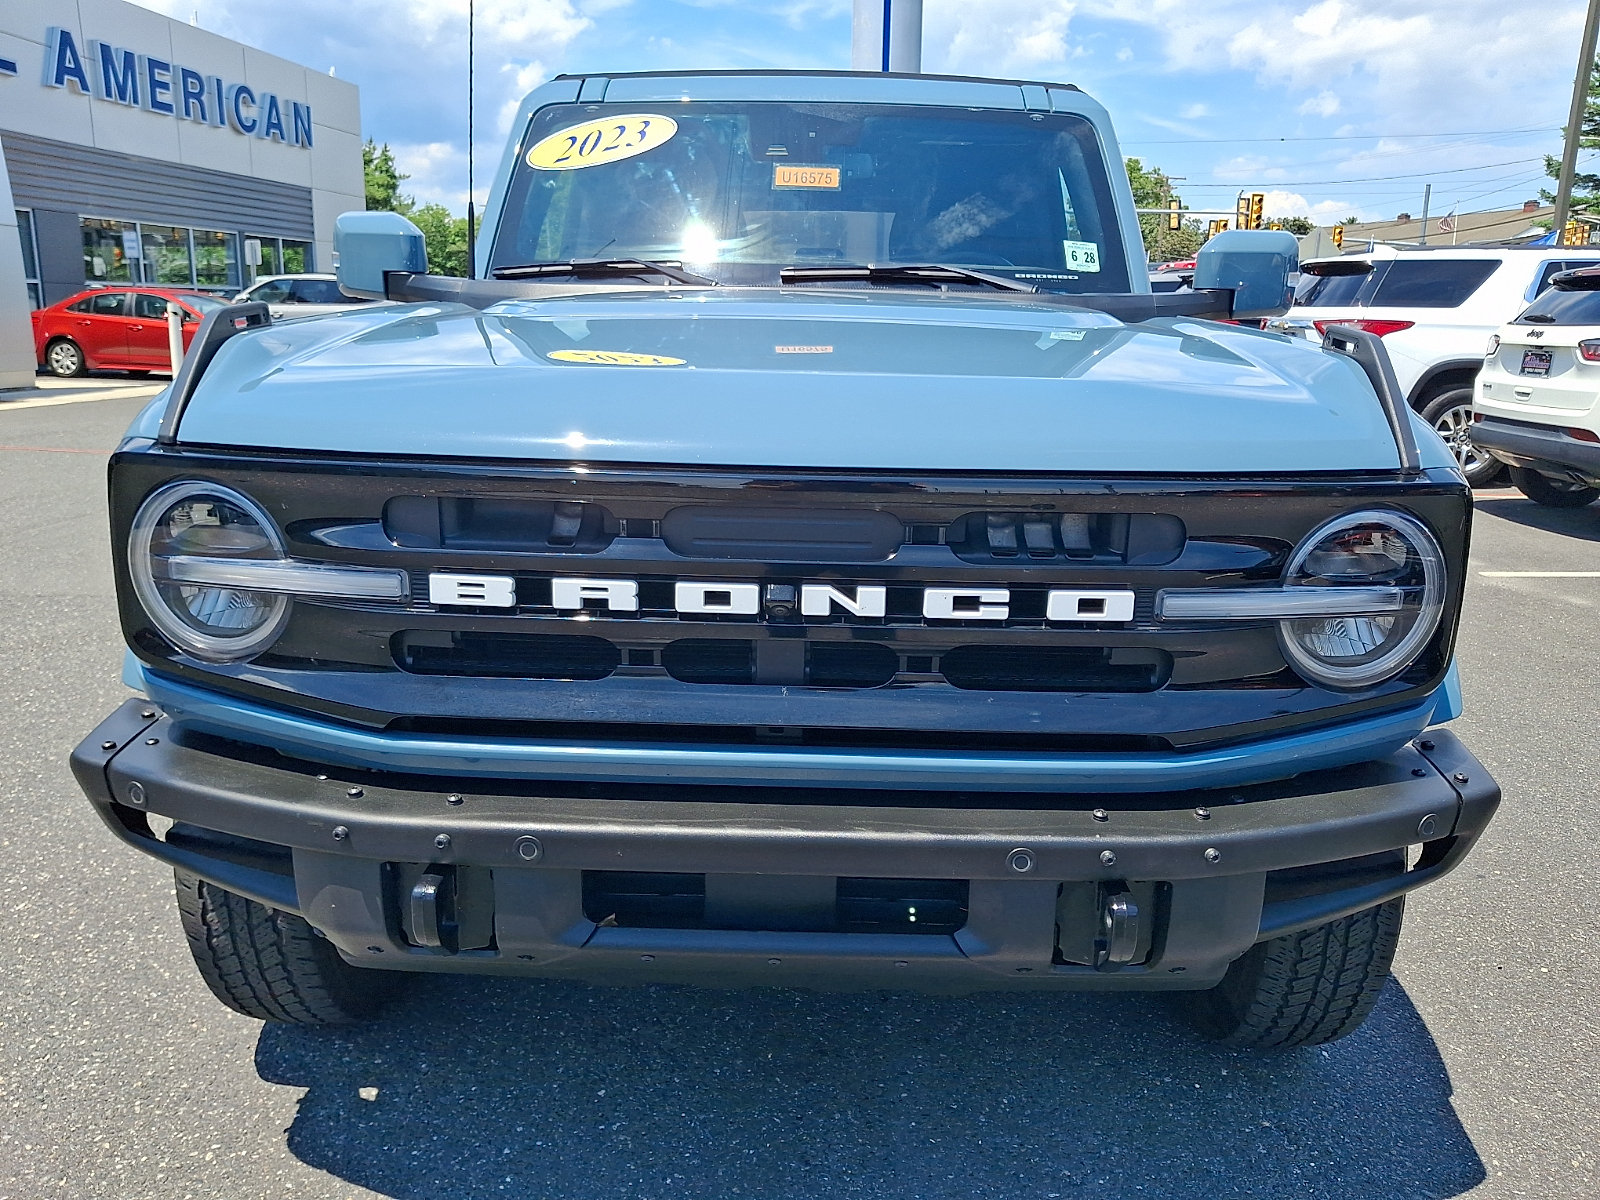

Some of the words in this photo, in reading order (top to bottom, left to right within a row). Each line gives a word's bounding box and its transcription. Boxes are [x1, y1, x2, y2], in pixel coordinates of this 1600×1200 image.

[47, 27, 313, 149] AMERICAN
[553, 120, 650, 164] 2023
[781, 170, 833, 185] U16575
[1071, 250, 1078, 262] 6
[1083, 251, 1096, 264] 28
[428, 572, 1136, 622] BRONCO
